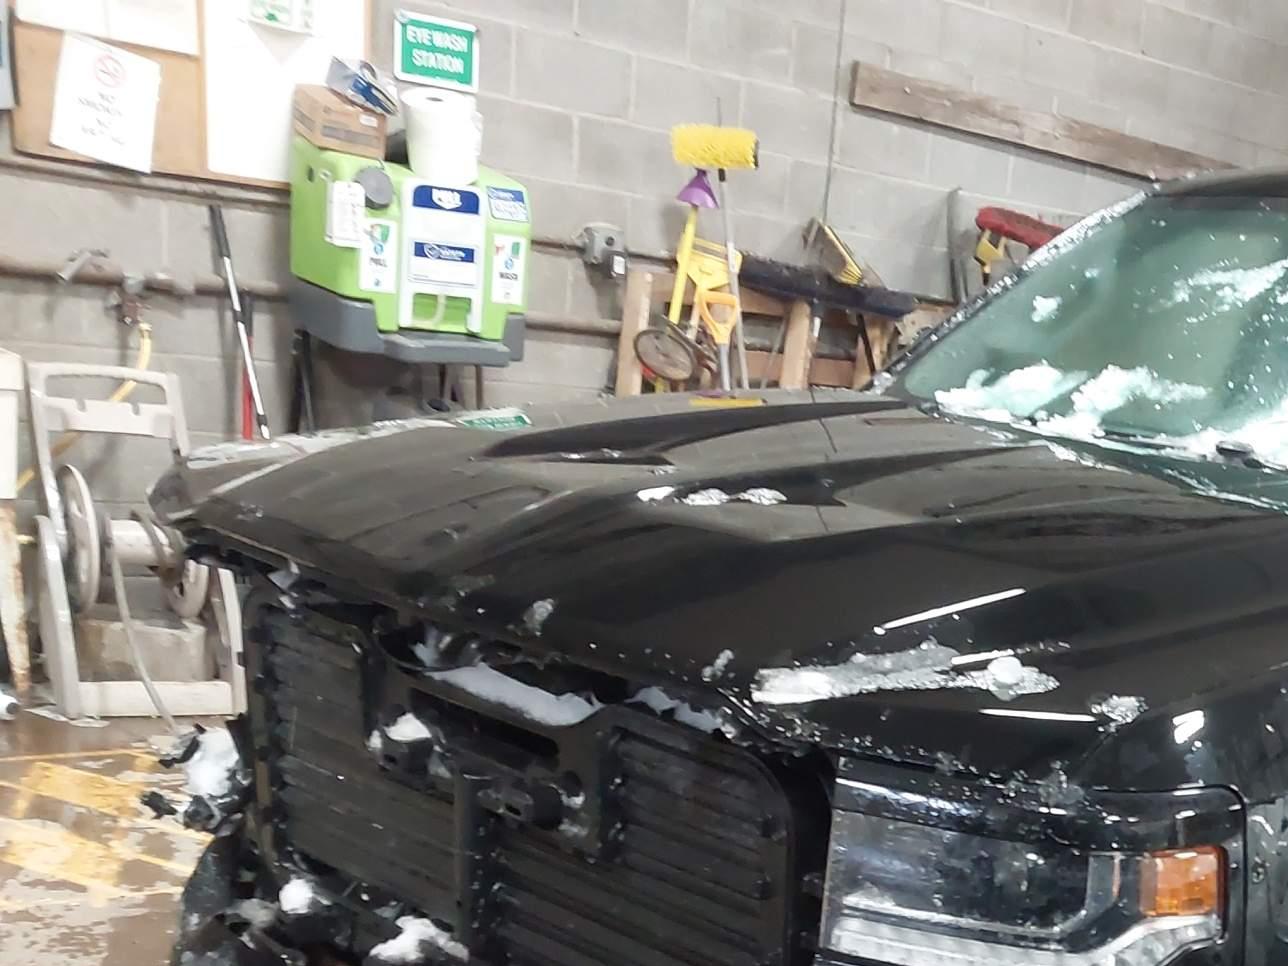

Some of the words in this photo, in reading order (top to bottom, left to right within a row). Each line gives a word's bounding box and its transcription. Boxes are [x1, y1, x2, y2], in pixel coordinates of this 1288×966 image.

[406, 24, 432, 46] EYE
[432, 30, 468, 53] WASH
[412, 48, 464, 74] STATION
